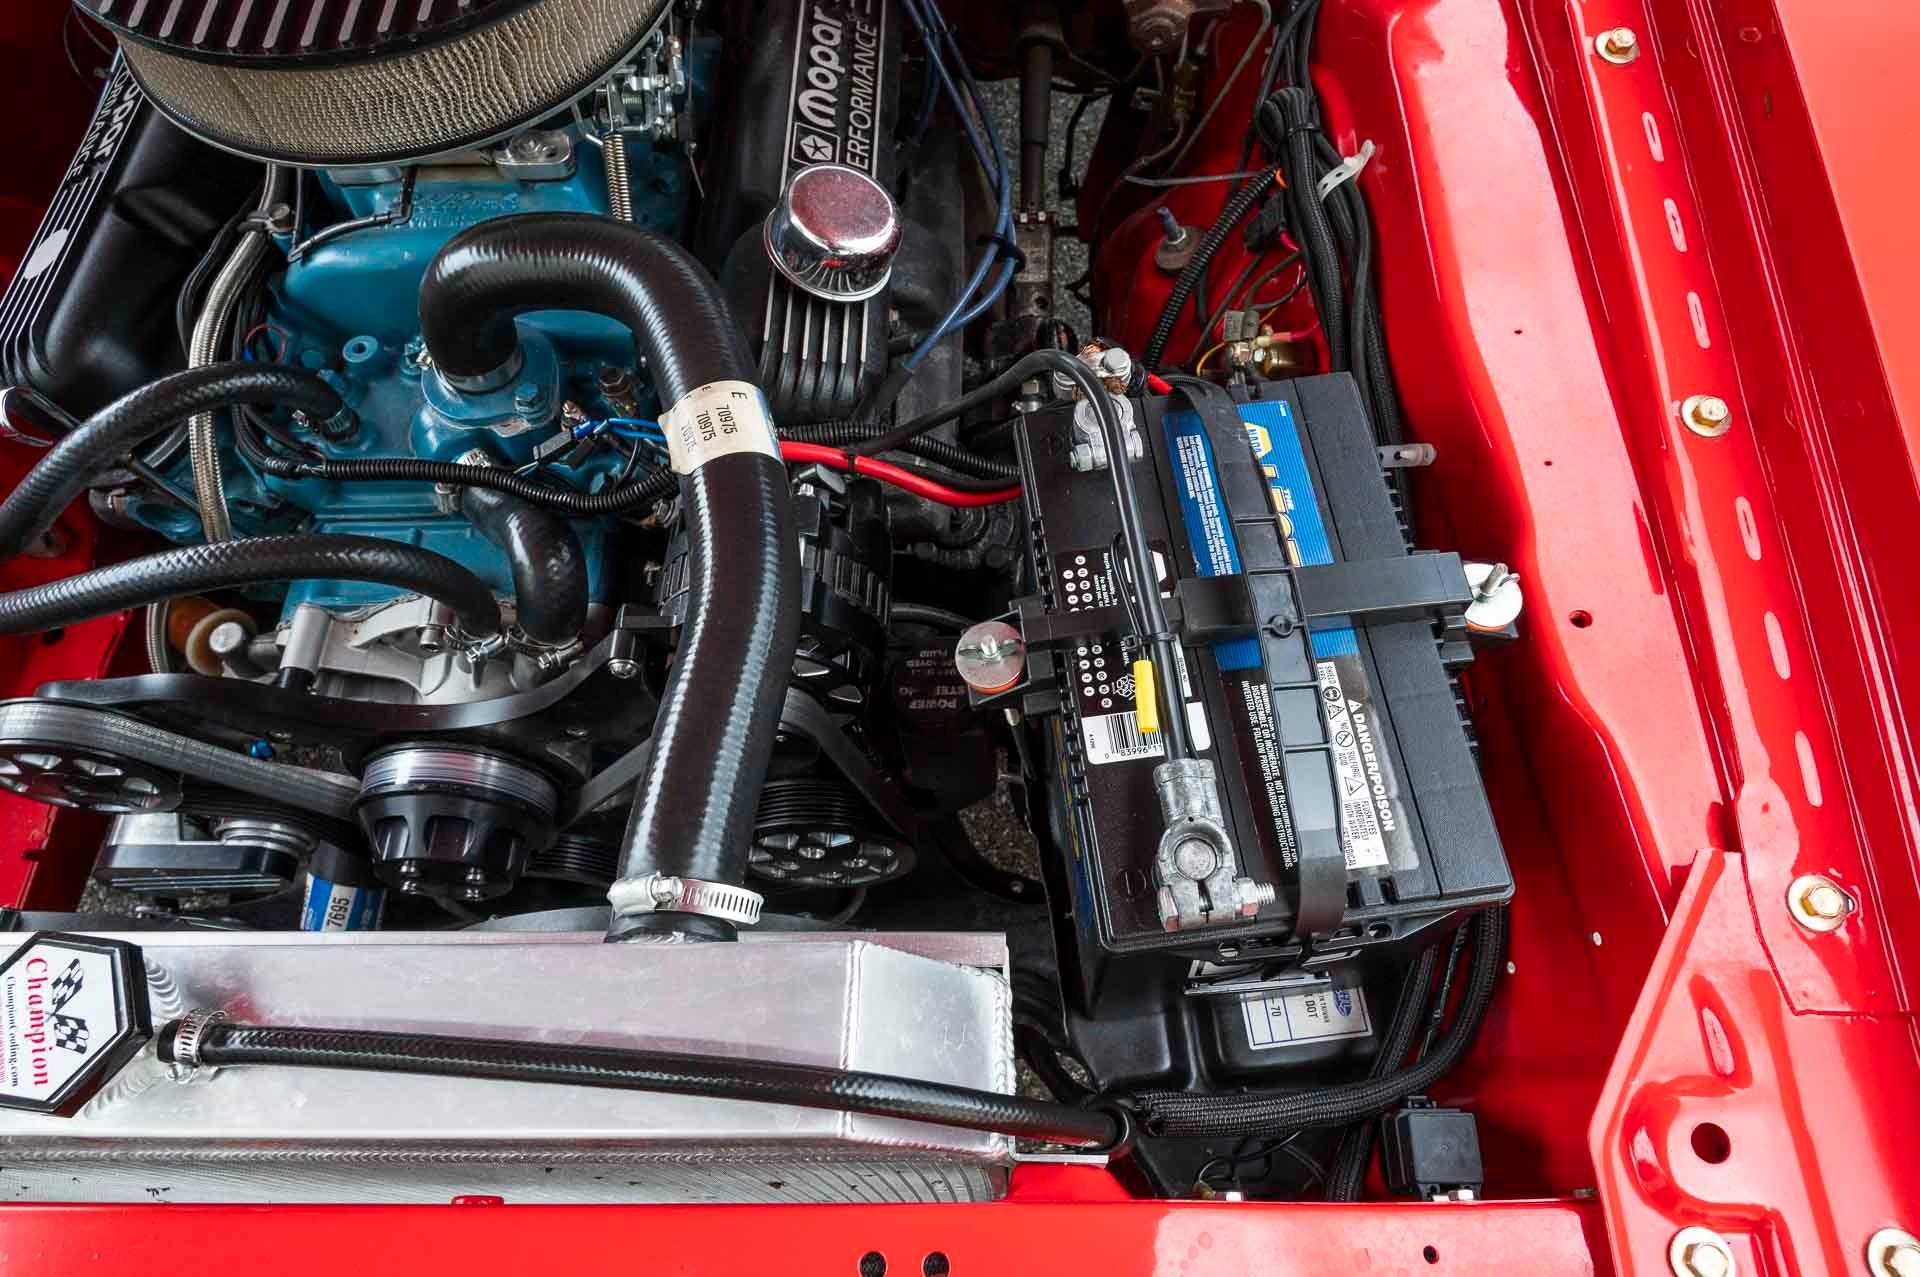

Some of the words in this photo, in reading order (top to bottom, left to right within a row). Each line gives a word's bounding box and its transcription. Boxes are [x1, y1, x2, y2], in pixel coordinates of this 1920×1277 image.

[799, 6, 845, 128] Mopar
[846, 20, 877, 170] ERFORMANCE
[94, 82, 140, 158] opar
[732, 392, 748, 400] E
[696, 410, 716, 441] 70975
[716, 404, 738, 434] 70975
[1324, 665, 1336, 684] SHIELD
[1240, 679, 1255, 711] INVERTED
[1250, 684, 1268, 729] DISASSEMBLE
[1248, 710, 1259, 727] USE.
[1252, 726, 1265, 754] FOLLOW
[1261, 728, 1270, 739] OR
[1119, 745, 1148, 756] 83996
[1263, 738, 1280, 779] INCINERATE.
[1337, 752, 1348, 766] ACID
[1258, 753, 1272, 782] PROPER
[1351, 709, 1396, 834] DANGER/POISON
[1265, 781, 1281, 817] CHARGING
[1273, 778, 1284, 794] NOT
[1343, 803, 1354, 818] WITH
[1351, 801, 1369, 840] IMMEDIATELY
[1359, 800, 1373, 819] FLUSH
[1347, 820, 1360, 839] WATER
[1365, 820, 1378, 836] EYES
[1274, 816, 1293, 870] INSTRUCTIONS.
[1342, 840, 1356, 865] MEDICAL
[327, 897, 350, 927] 7695
[24, 958, 53, 1086] Champion
[1305, 1000, 1318, 1018] DOT
[6, 976, 19, 1086] ChampionCooling.com
